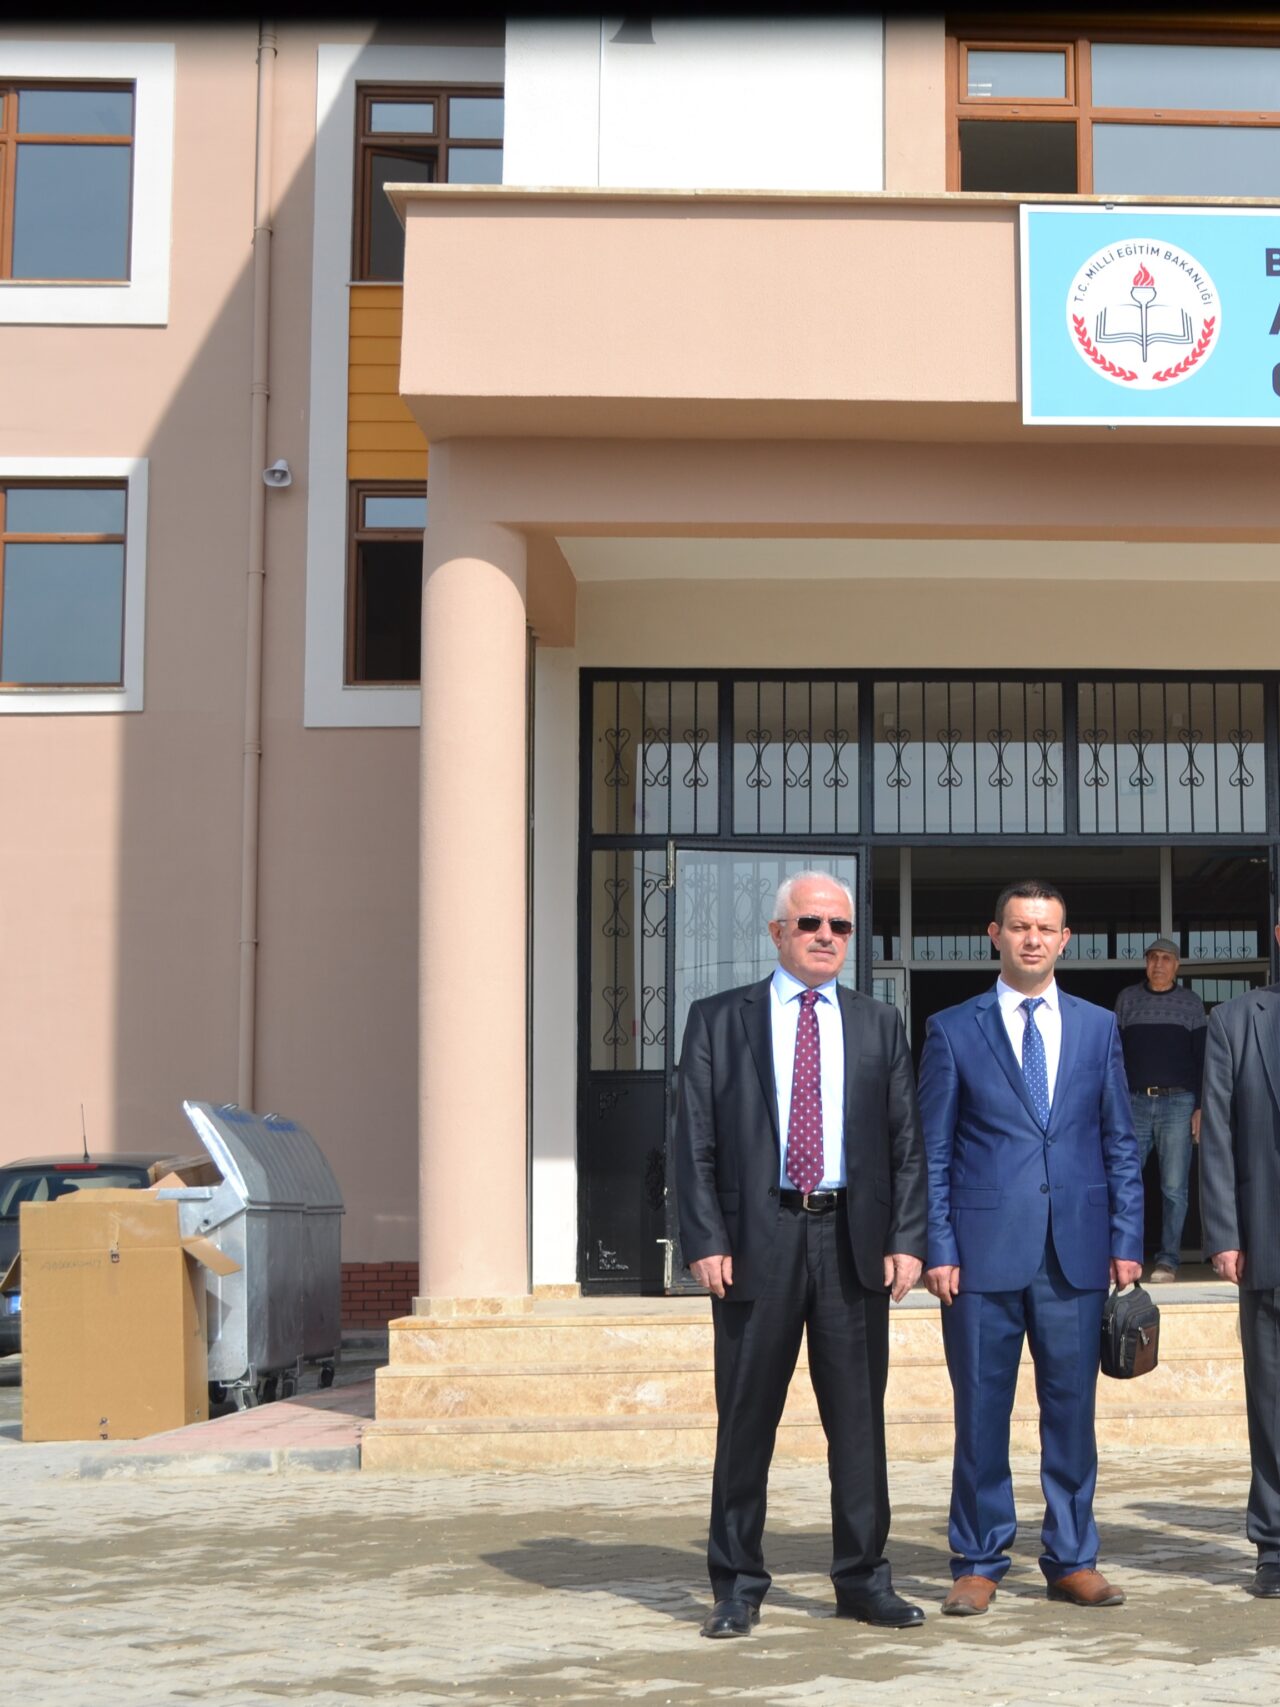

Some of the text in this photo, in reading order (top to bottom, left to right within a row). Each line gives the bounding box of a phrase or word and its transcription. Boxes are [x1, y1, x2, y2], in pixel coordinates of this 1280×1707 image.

[1074, 243, 1213, 305] T.C. MİLLİ EĞİTİM BAKANLIĞI
